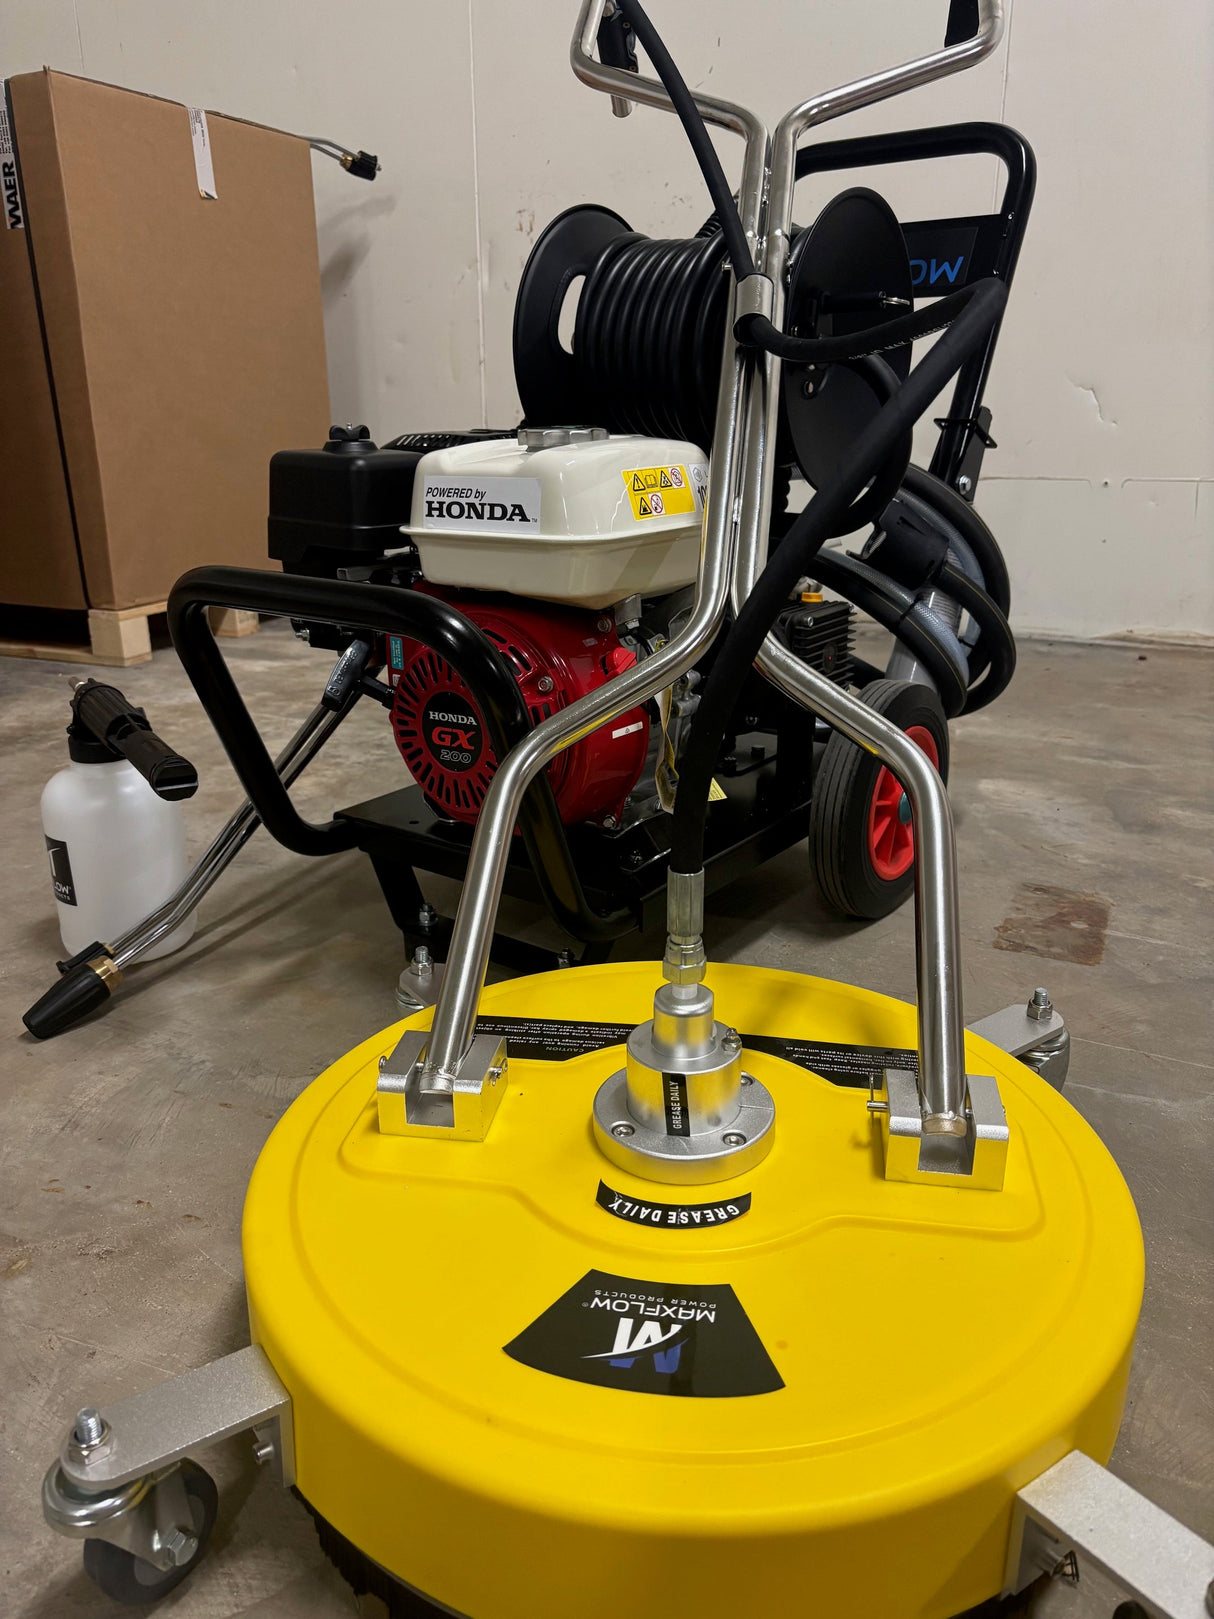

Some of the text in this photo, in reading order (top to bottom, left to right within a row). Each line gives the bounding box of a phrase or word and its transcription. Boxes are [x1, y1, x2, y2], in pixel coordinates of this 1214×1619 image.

[426, 487, 486, 500] POWERED by
[425, 500, 530, 522] HONDA
[429, 711, 478, 726] HONDA
[432, 726, 476, 750] GX
[440, 750, 472, 764] 200
[669, 1080, 682, 1129] GREASE DAILY
[608, 1198, 740, 1224] GREASE DAILY
[594, 1289, 716, 1309] POWER PRODUCTS
